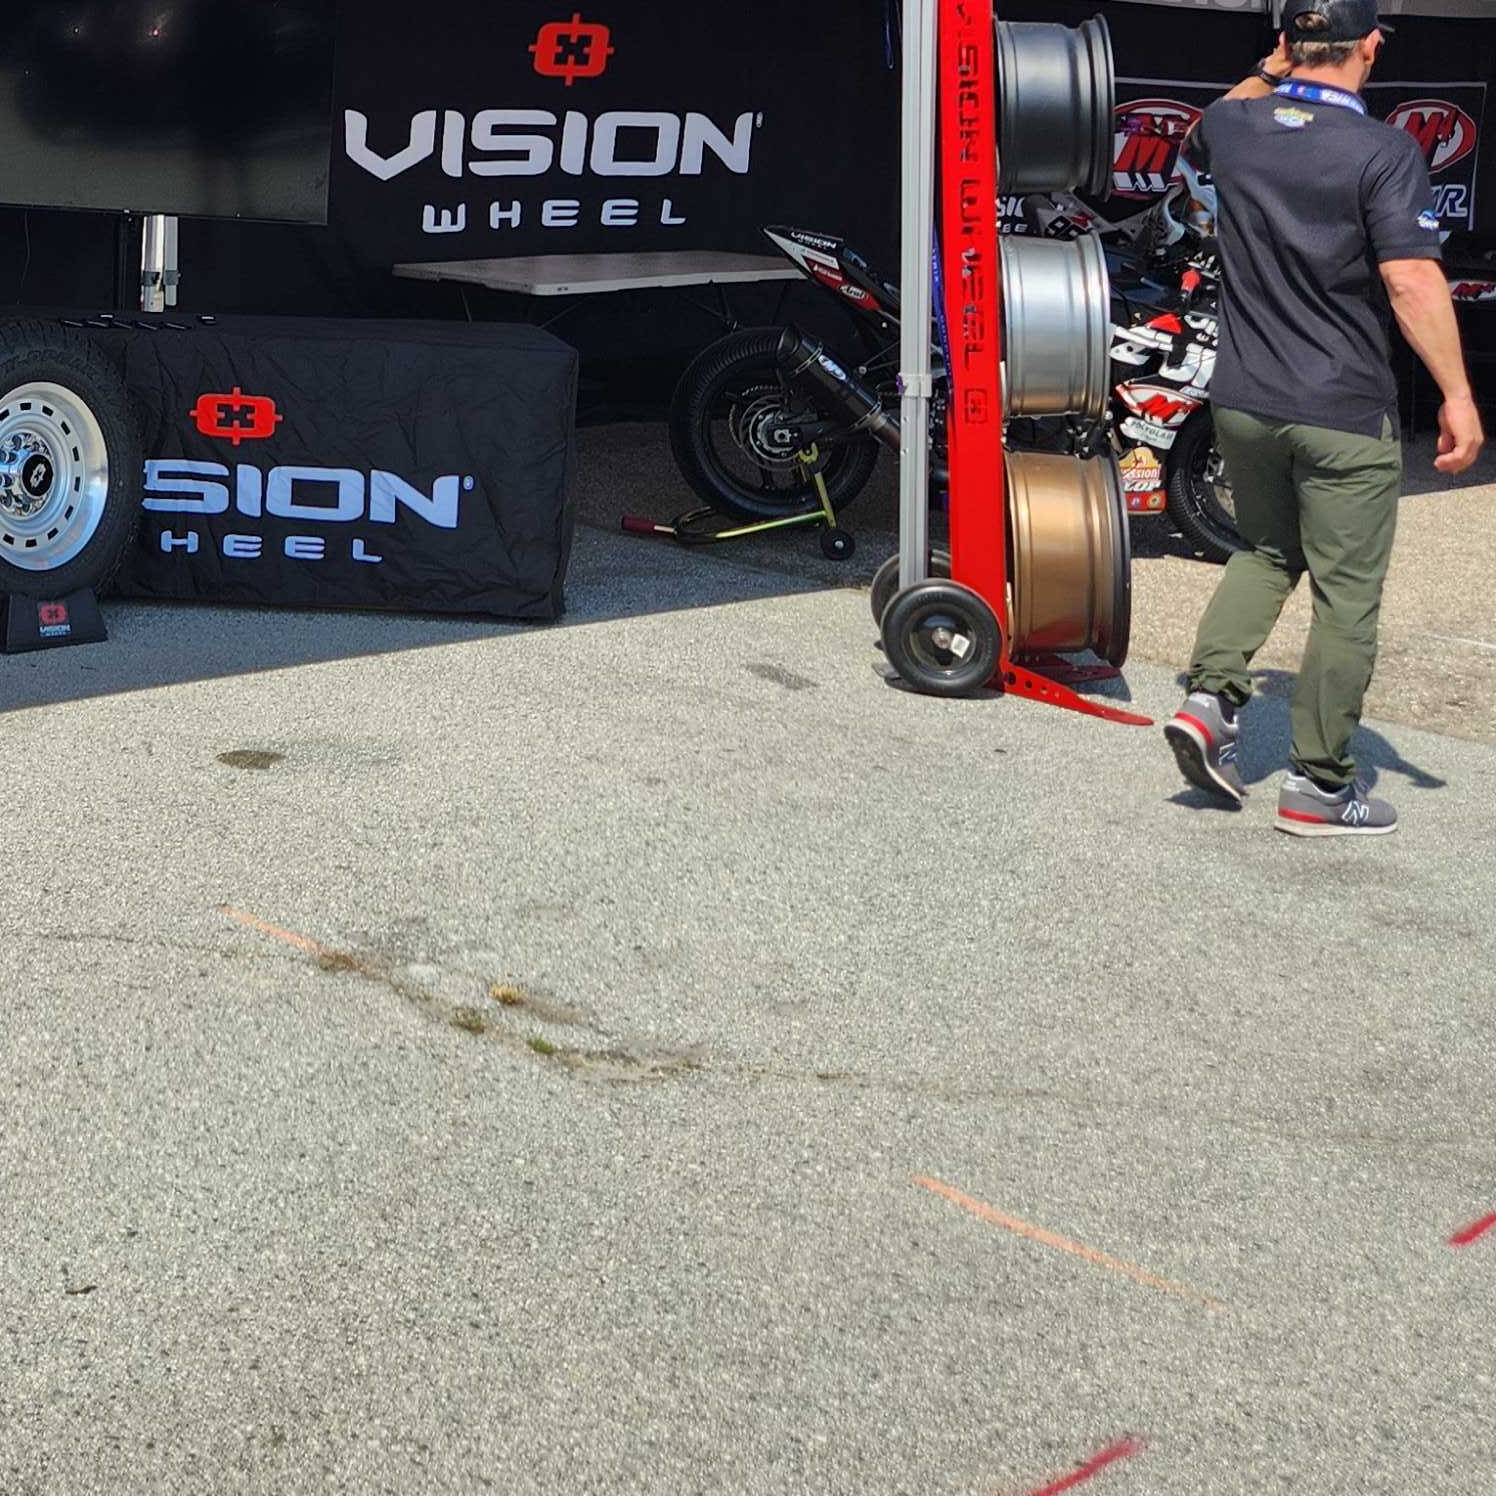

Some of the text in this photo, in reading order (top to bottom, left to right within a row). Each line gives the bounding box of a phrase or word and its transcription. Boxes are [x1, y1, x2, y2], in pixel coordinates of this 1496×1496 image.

[344, 110, 754, 181] VISION
[422, 199, 686, 234] WHEEL
[141, 457, 460, 530] SION
[160, 530, 383, 564] HEEL
